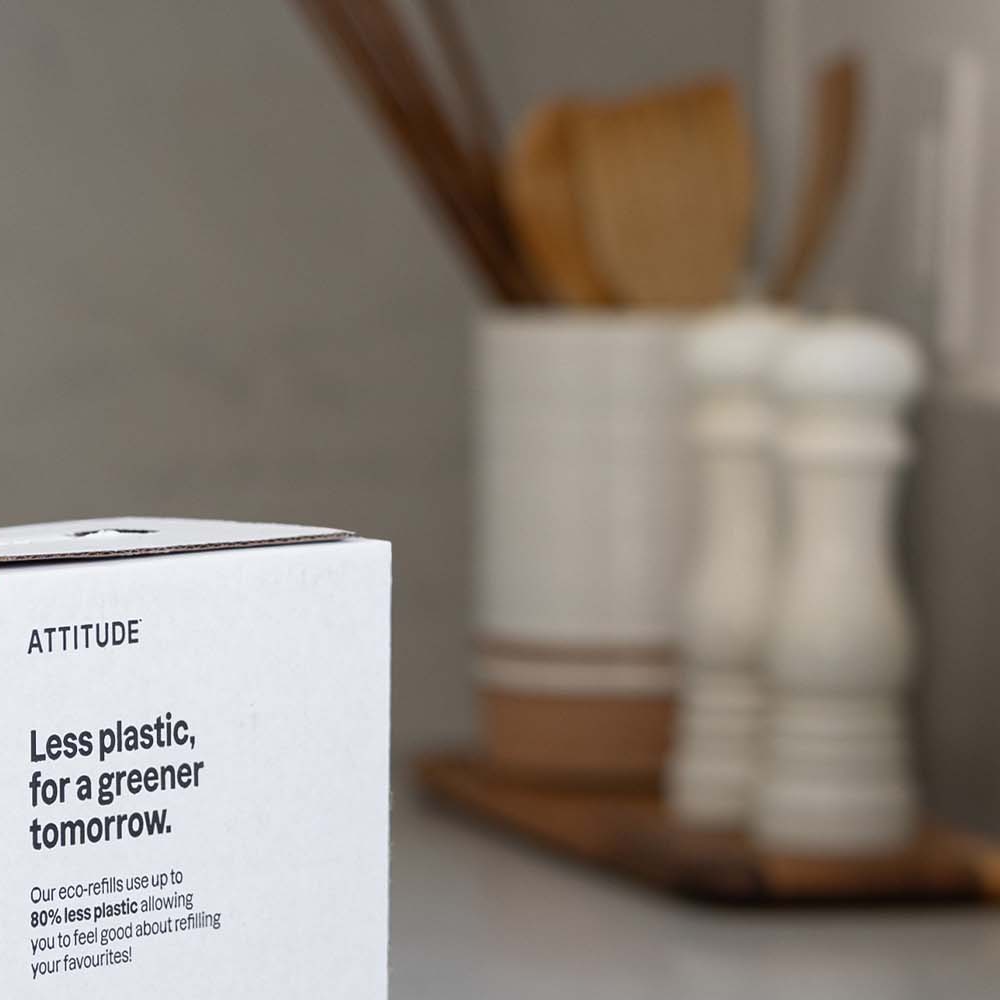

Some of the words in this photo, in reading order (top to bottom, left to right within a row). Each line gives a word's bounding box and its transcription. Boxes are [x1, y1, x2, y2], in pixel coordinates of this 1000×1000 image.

[27, 619, 140, 654] ATTITUDE
[30, 729, 93, 762] Less
[99, 711, 195, 762] plastic,
[29, 771, 70, 807] for
[75, 775, 92, 800] a
[98, 761, 204, 806] greener
[29, 809, 172, 850] tomorrow.
[30, 886, 56, 904] Our
[58, 876, 124, 900] eco-refills
[125, 876, 149, 891] use
[151, 872, 168, 890] up
[170, 868, 184, 885] to
[30, 908, 62, 928] 80%
[64, 906, 91, 923] less
[93, 898, 138, 922] plastic
[140, 892, 194, 912] allowing
[30, 936, 55, 955] you
[58, 932, 71, 948] to
[73, 927, 98, 946] feel
[100, 922, 133, 945] good
[135, 919, 172, 937] about
[174, 911, 221, 932] refilling
[30, 959, 61, 980] your
[63, 947, 132, 972] favourites!
